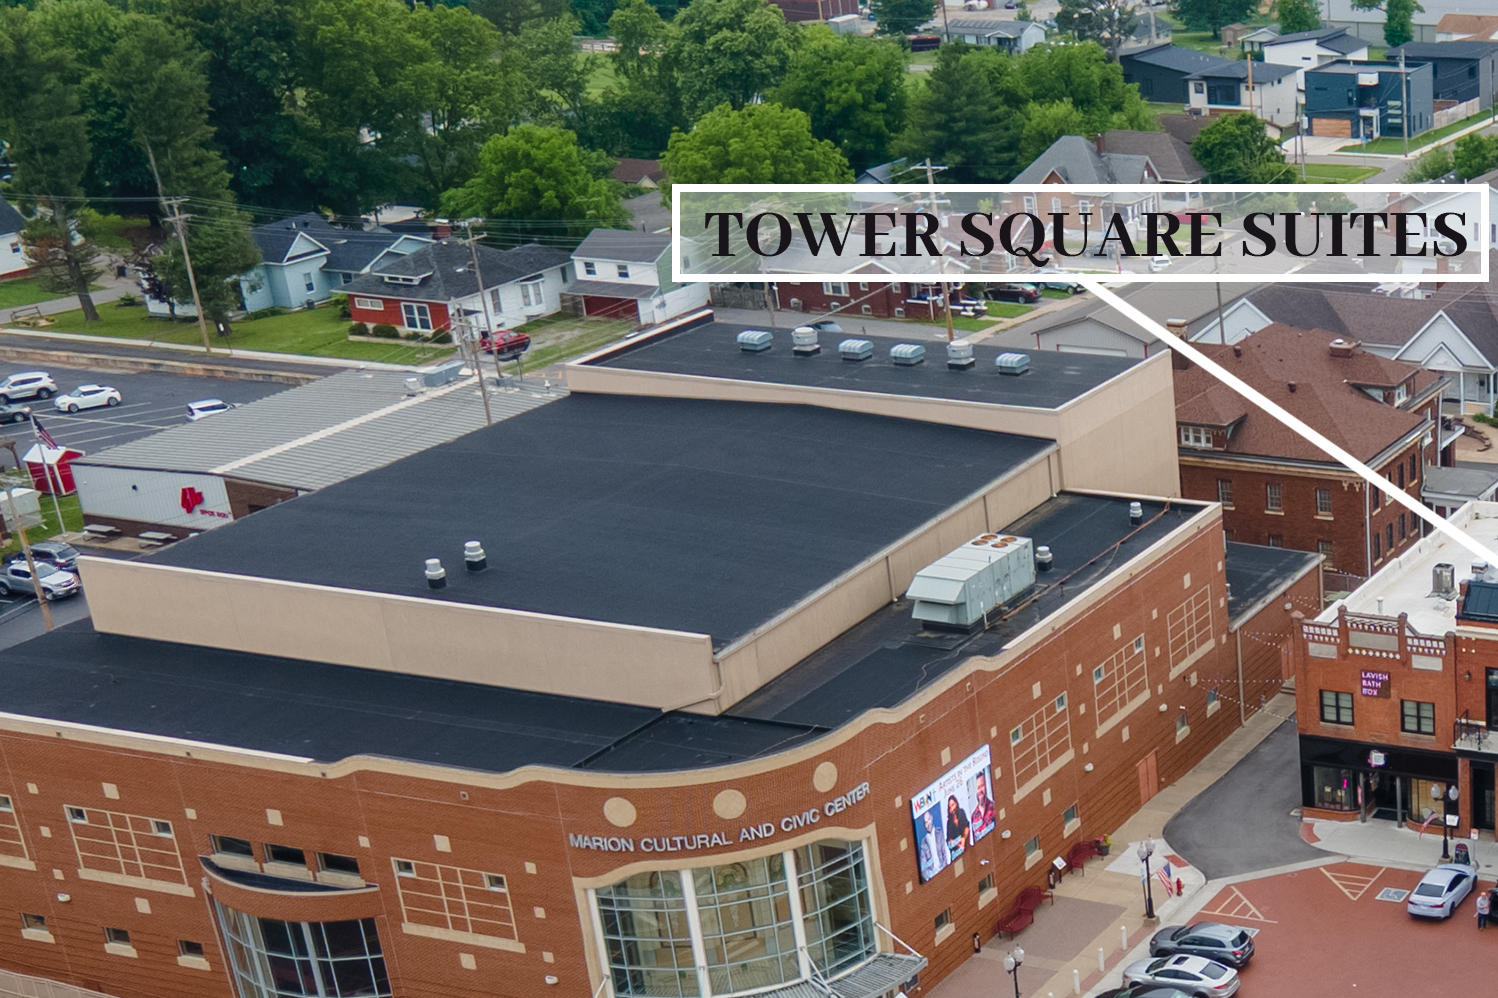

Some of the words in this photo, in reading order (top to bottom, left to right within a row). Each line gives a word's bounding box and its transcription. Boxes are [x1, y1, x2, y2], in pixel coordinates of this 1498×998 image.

[1361, 671, 1389, 681] LAVISH
[1362, 679, 1382, 688] BATH
[1362, 687, 1378, 696] BOX
[568, 832, 635, 853] MARION
[640, 832, 734, 853] CULTURAL
[739, 822, 776, 843] AND
[780, 808, 821, 832] CIVIC
[824, 781, 871, 817] CENTER
